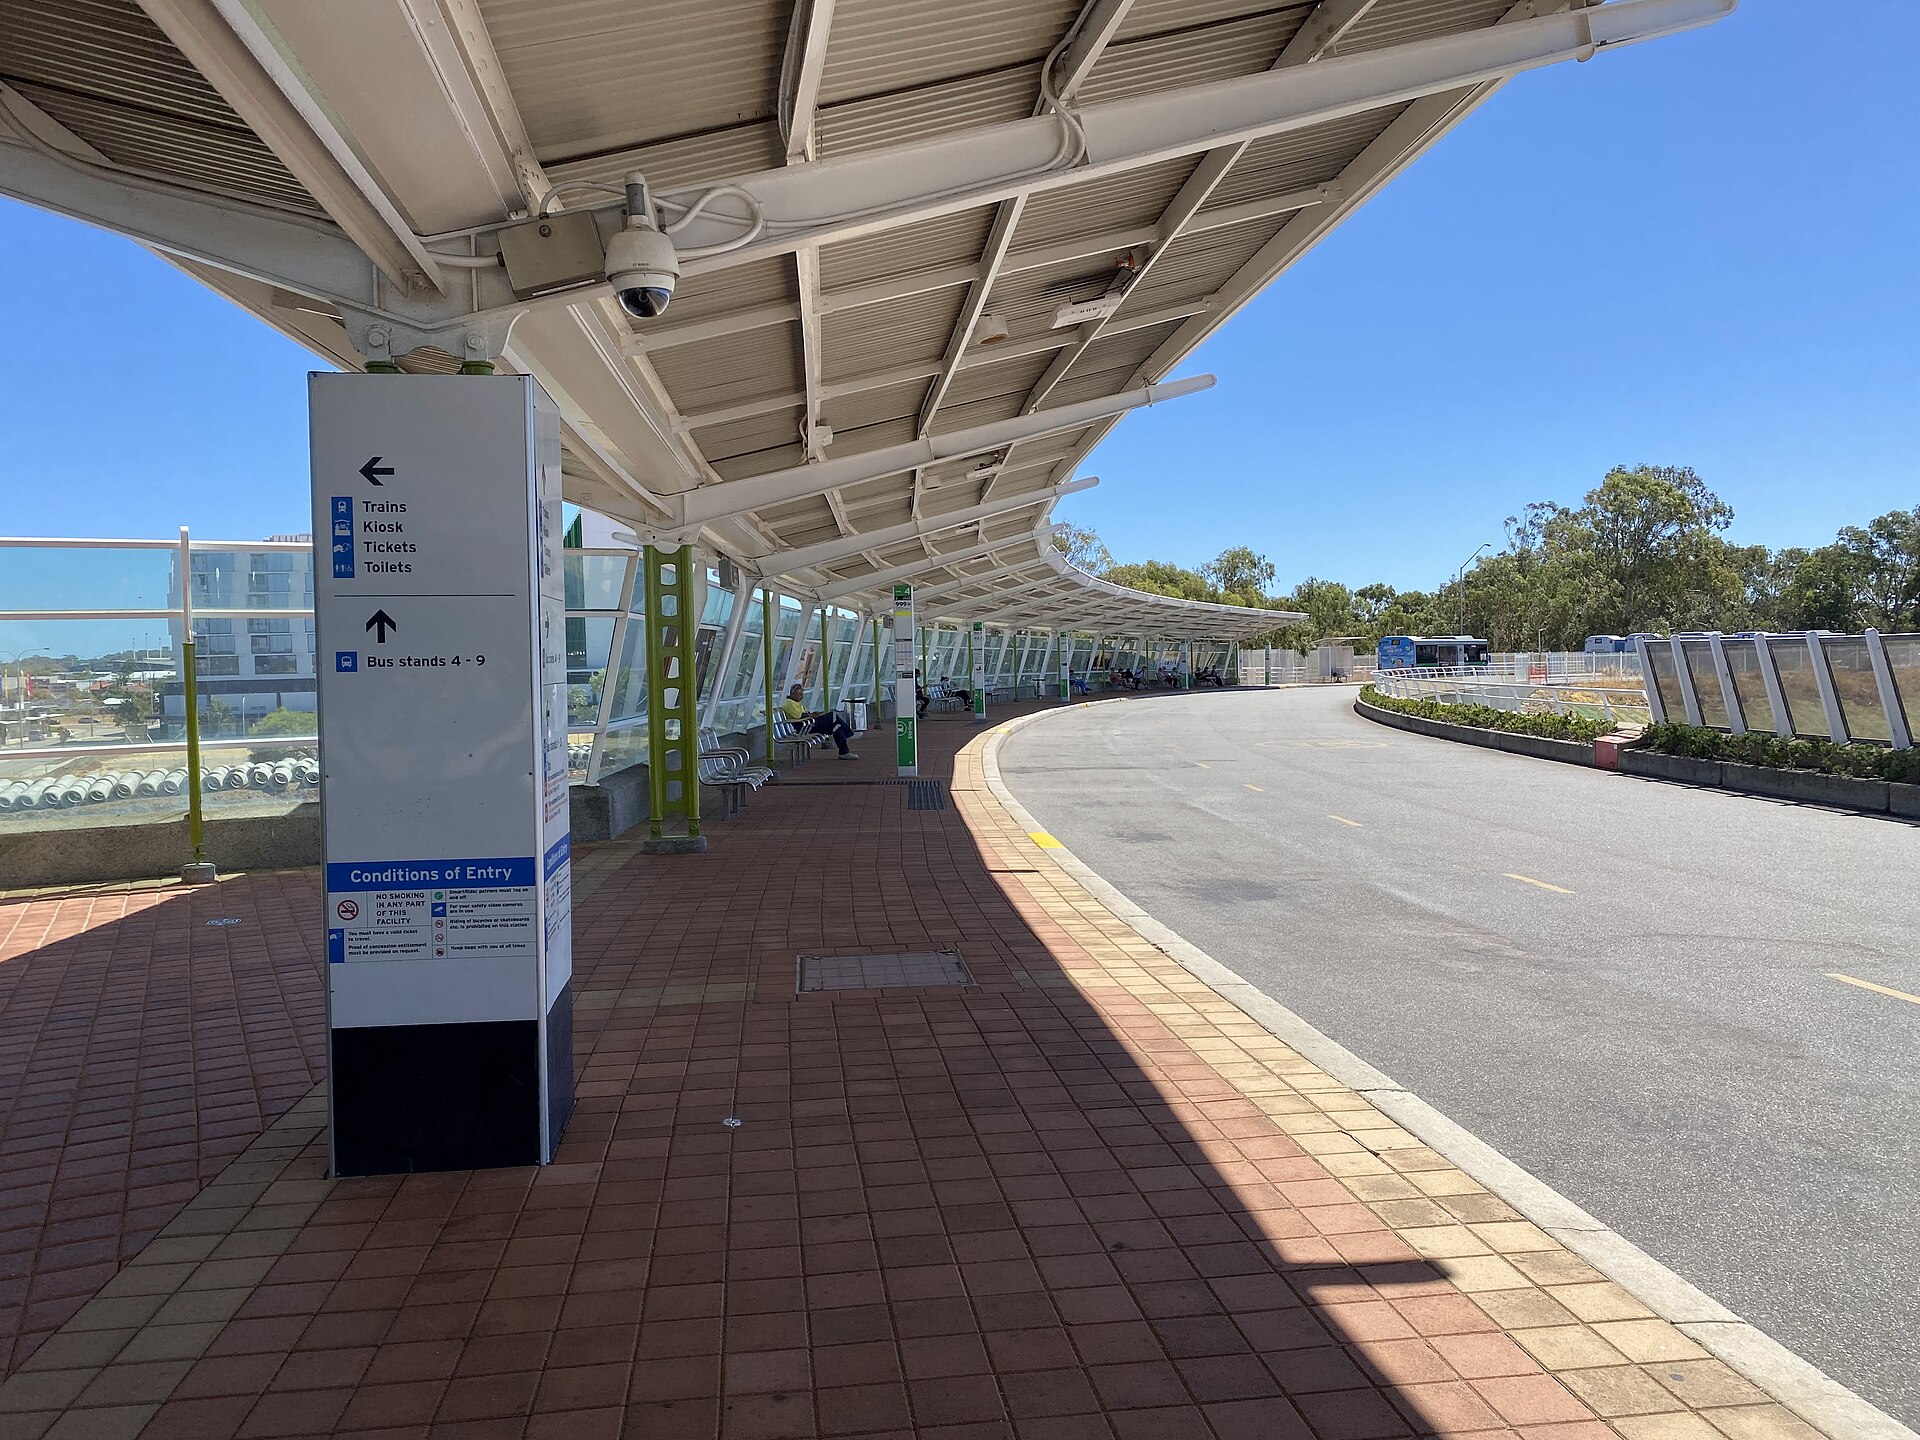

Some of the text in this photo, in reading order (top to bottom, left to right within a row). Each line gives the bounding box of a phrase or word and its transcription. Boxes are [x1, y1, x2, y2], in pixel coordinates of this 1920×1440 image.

[362, 501, 406, 512] Trains
[364, 521, 403, 532] Kiosk
[364, 541, 416, 552] Tickets
[364, 561, 412, 572] Toilets
[368, 656, 394, 667] Bus
[399, 656, 446, 666] stands
[451, 656, 461, 666] 4
[476, 655, 485, 666] 9
[351, 866, 512, 882] Conditions of Entry
